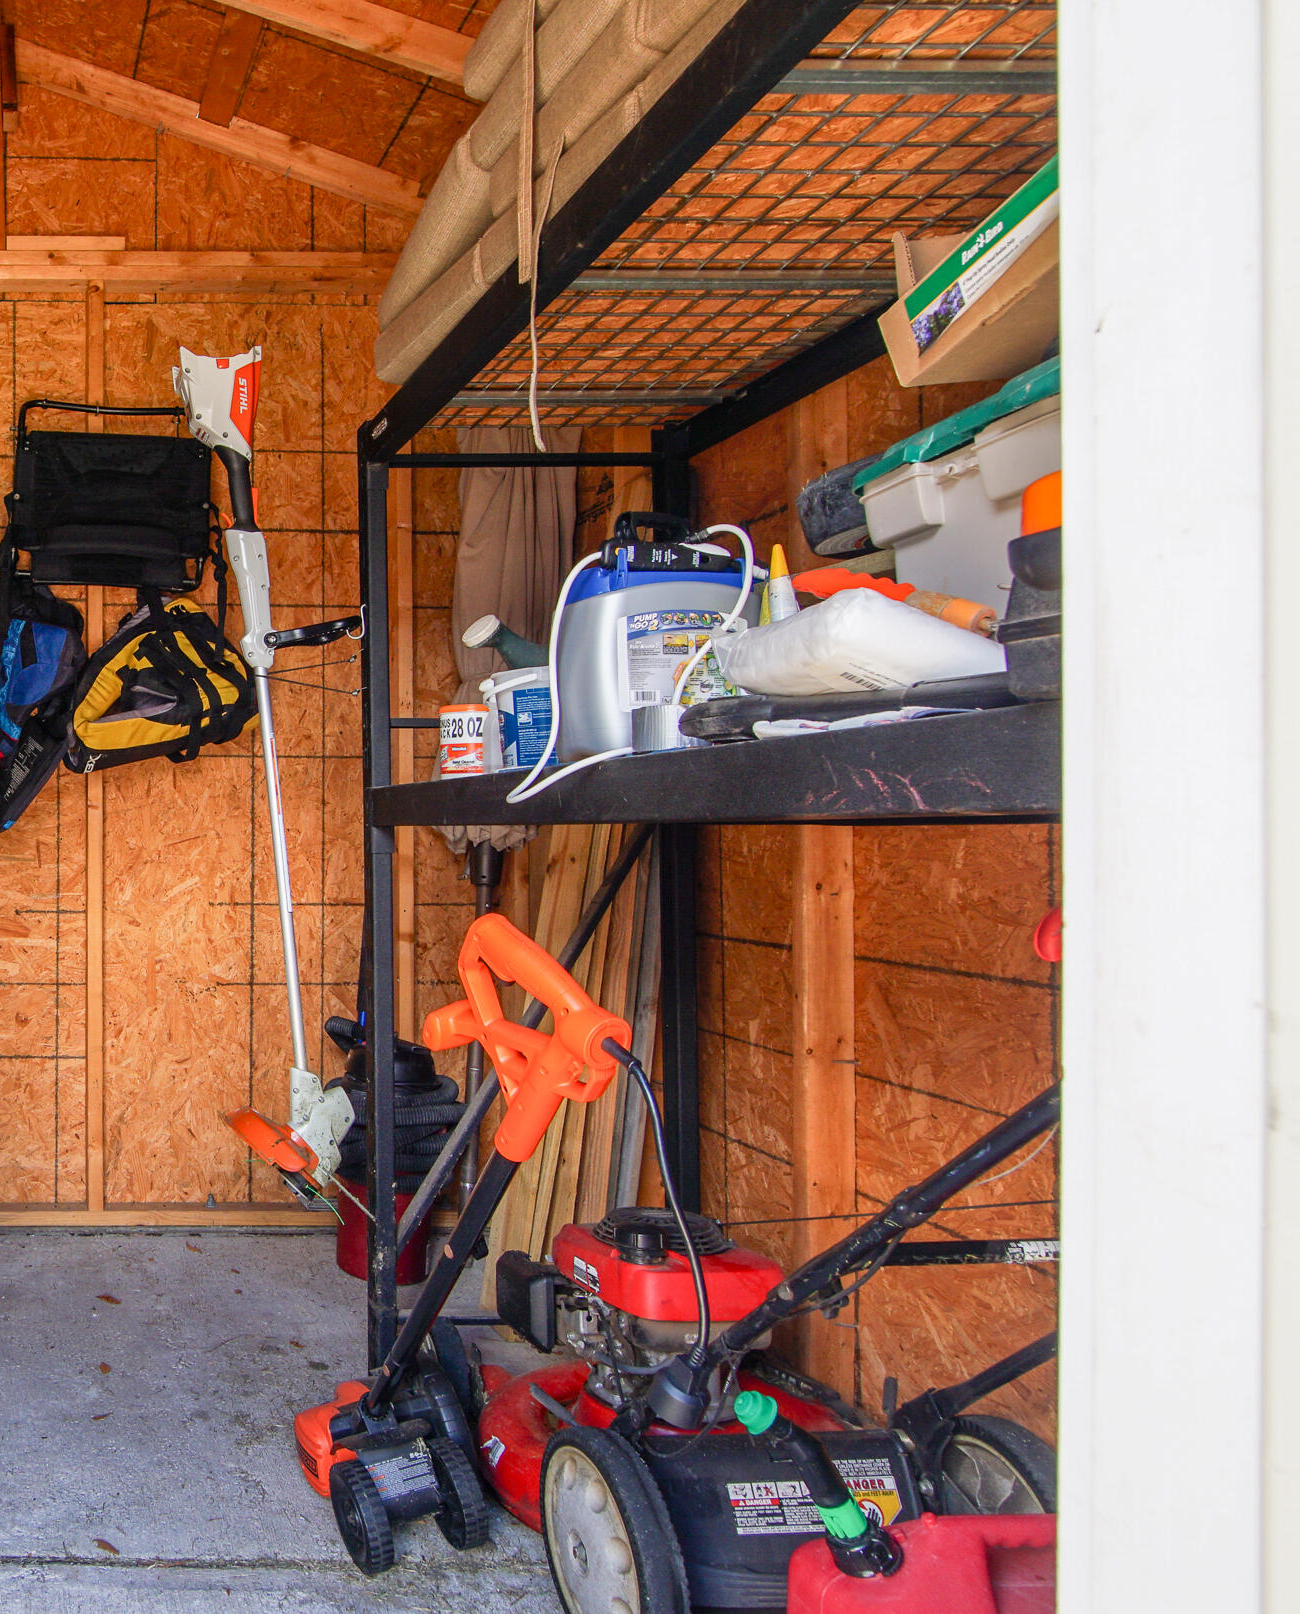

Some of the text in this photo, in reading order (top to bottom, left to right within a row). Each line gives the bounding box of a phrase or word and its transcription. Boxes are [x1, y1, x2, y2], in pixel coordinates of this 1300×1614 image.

[238, 377, 248, 414] STIHL
[634, 613, 657, 623] PUMP
[635, 622, 649, 630] GO
[649, 621, 659, 631] 2
[451, 717, 464, 738] 28
[467, 716, 483, 738] OZ
[845, 1479, 886, 1490] ANGER
